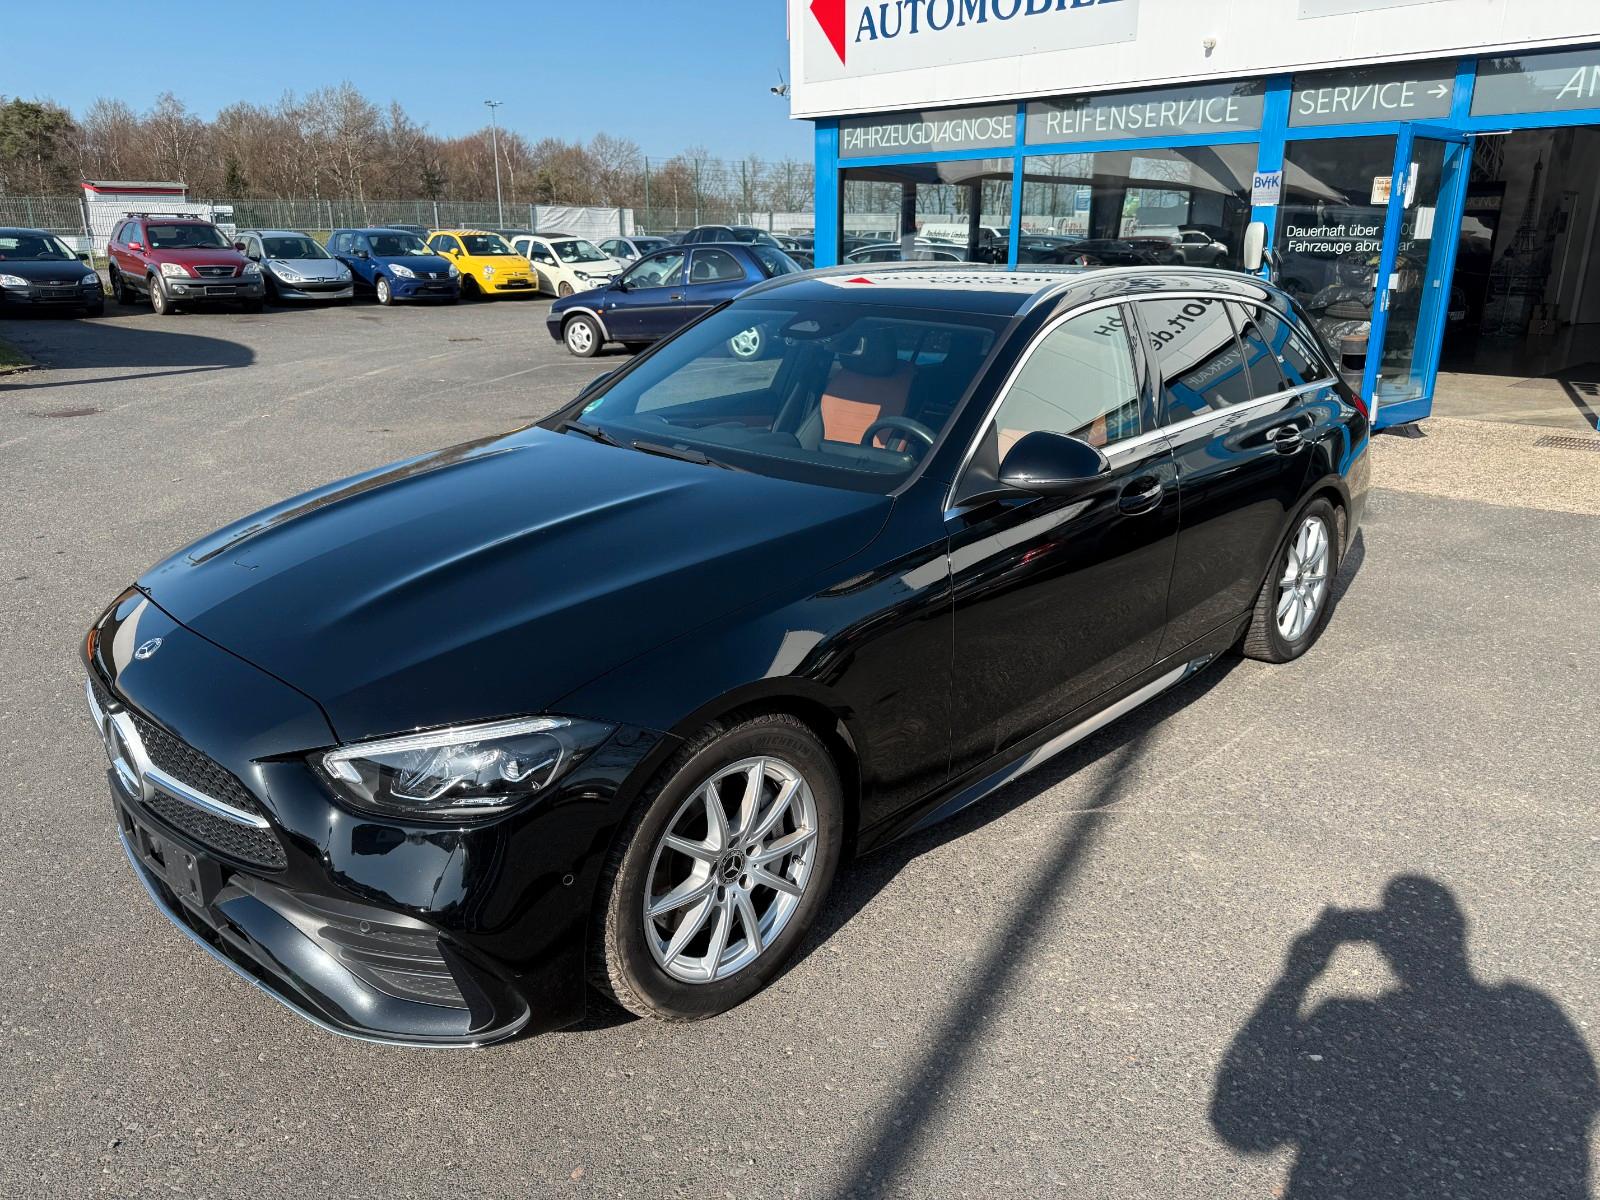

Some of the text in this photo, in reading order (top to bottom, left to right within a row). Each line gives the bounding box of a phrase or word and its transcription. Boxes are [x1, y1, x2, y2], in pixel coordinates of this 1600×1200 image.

[1298, 80, 1418, 115] SERVICE
[1046, 96, 1240, 135] REIFENSERVICE
[844, 115, 1013, 149] FAHRZEUGDIAGNOSE
[1254, 175, 1280, 190] BVfK
[1286, 224, 1345, 237] Dauerhaft
[1349, 224, 1380, 237] über
[1288, 238, 1412, 255] Fahrzeuge abruar
